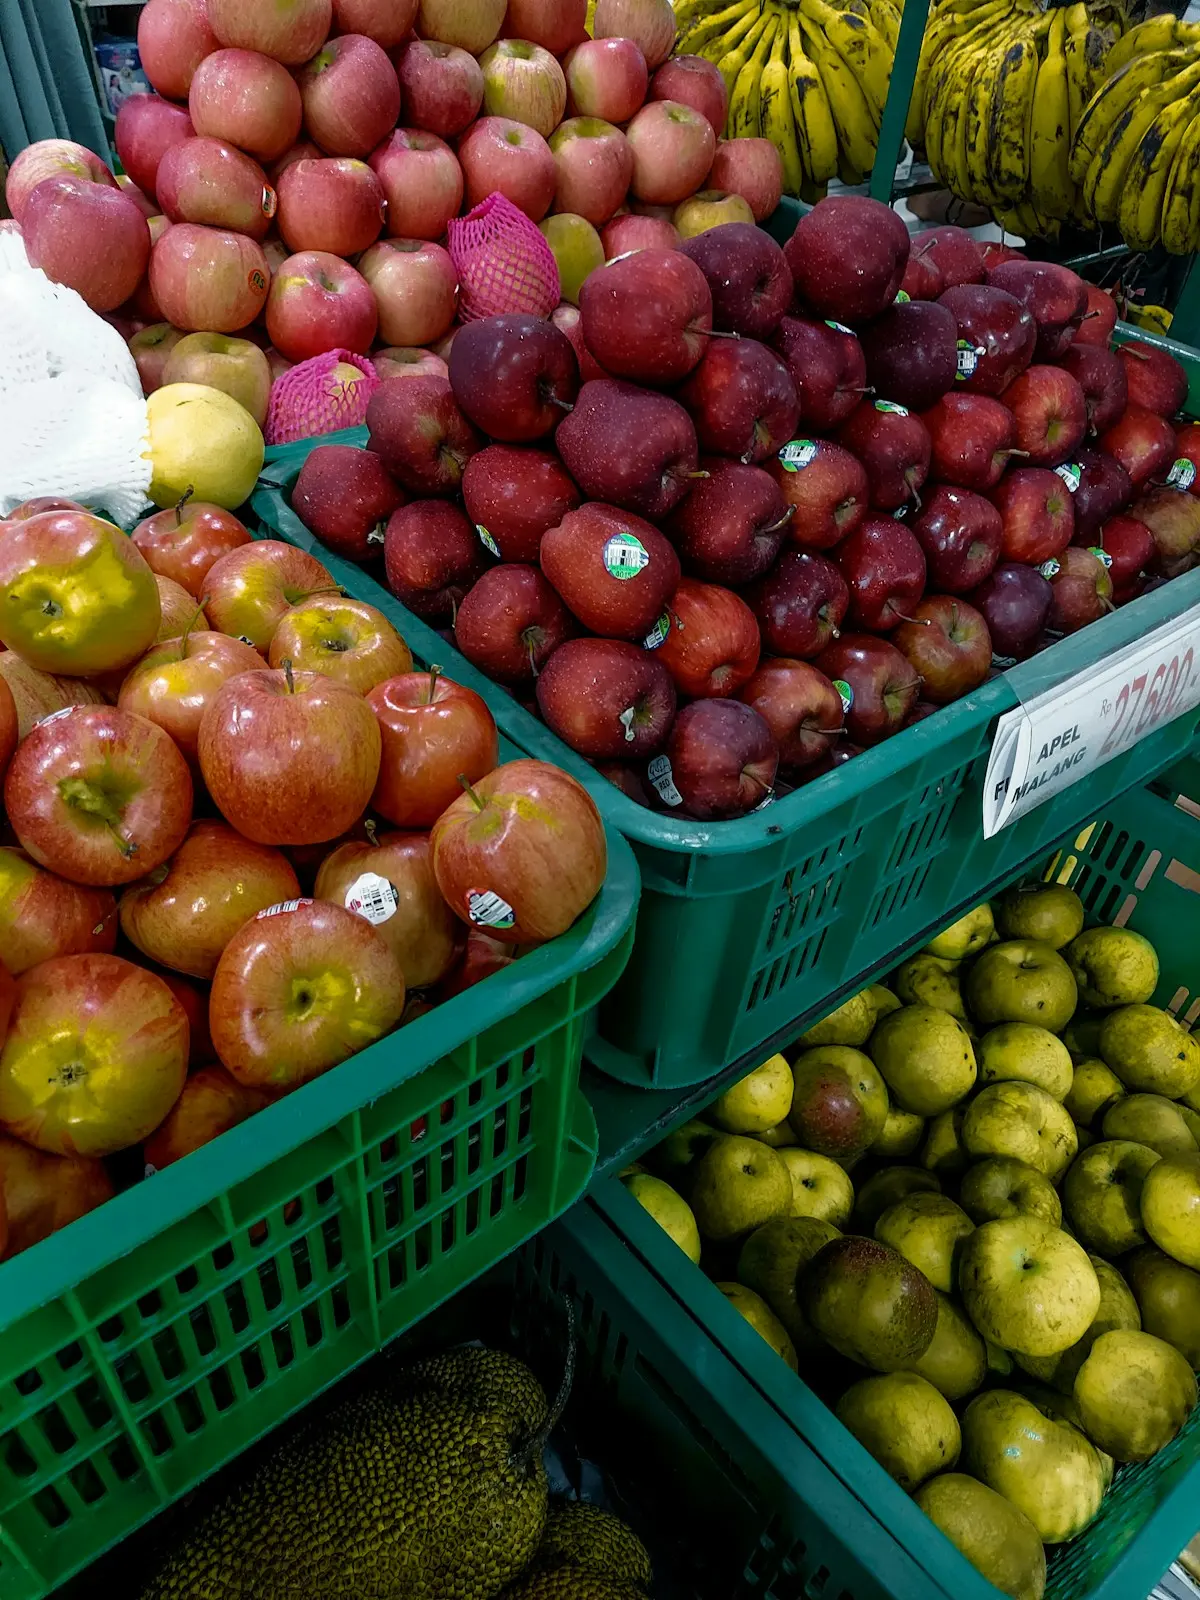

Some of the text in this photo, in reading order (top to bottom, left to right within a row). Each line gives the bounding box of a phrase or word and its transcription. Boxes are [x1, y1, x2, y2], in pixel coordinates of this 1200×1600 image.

[1100, 699, 1112, 718] Rp
[1036, 724, 1081, 765] APEL
[1011, 746, 1087, 804] MALANG
